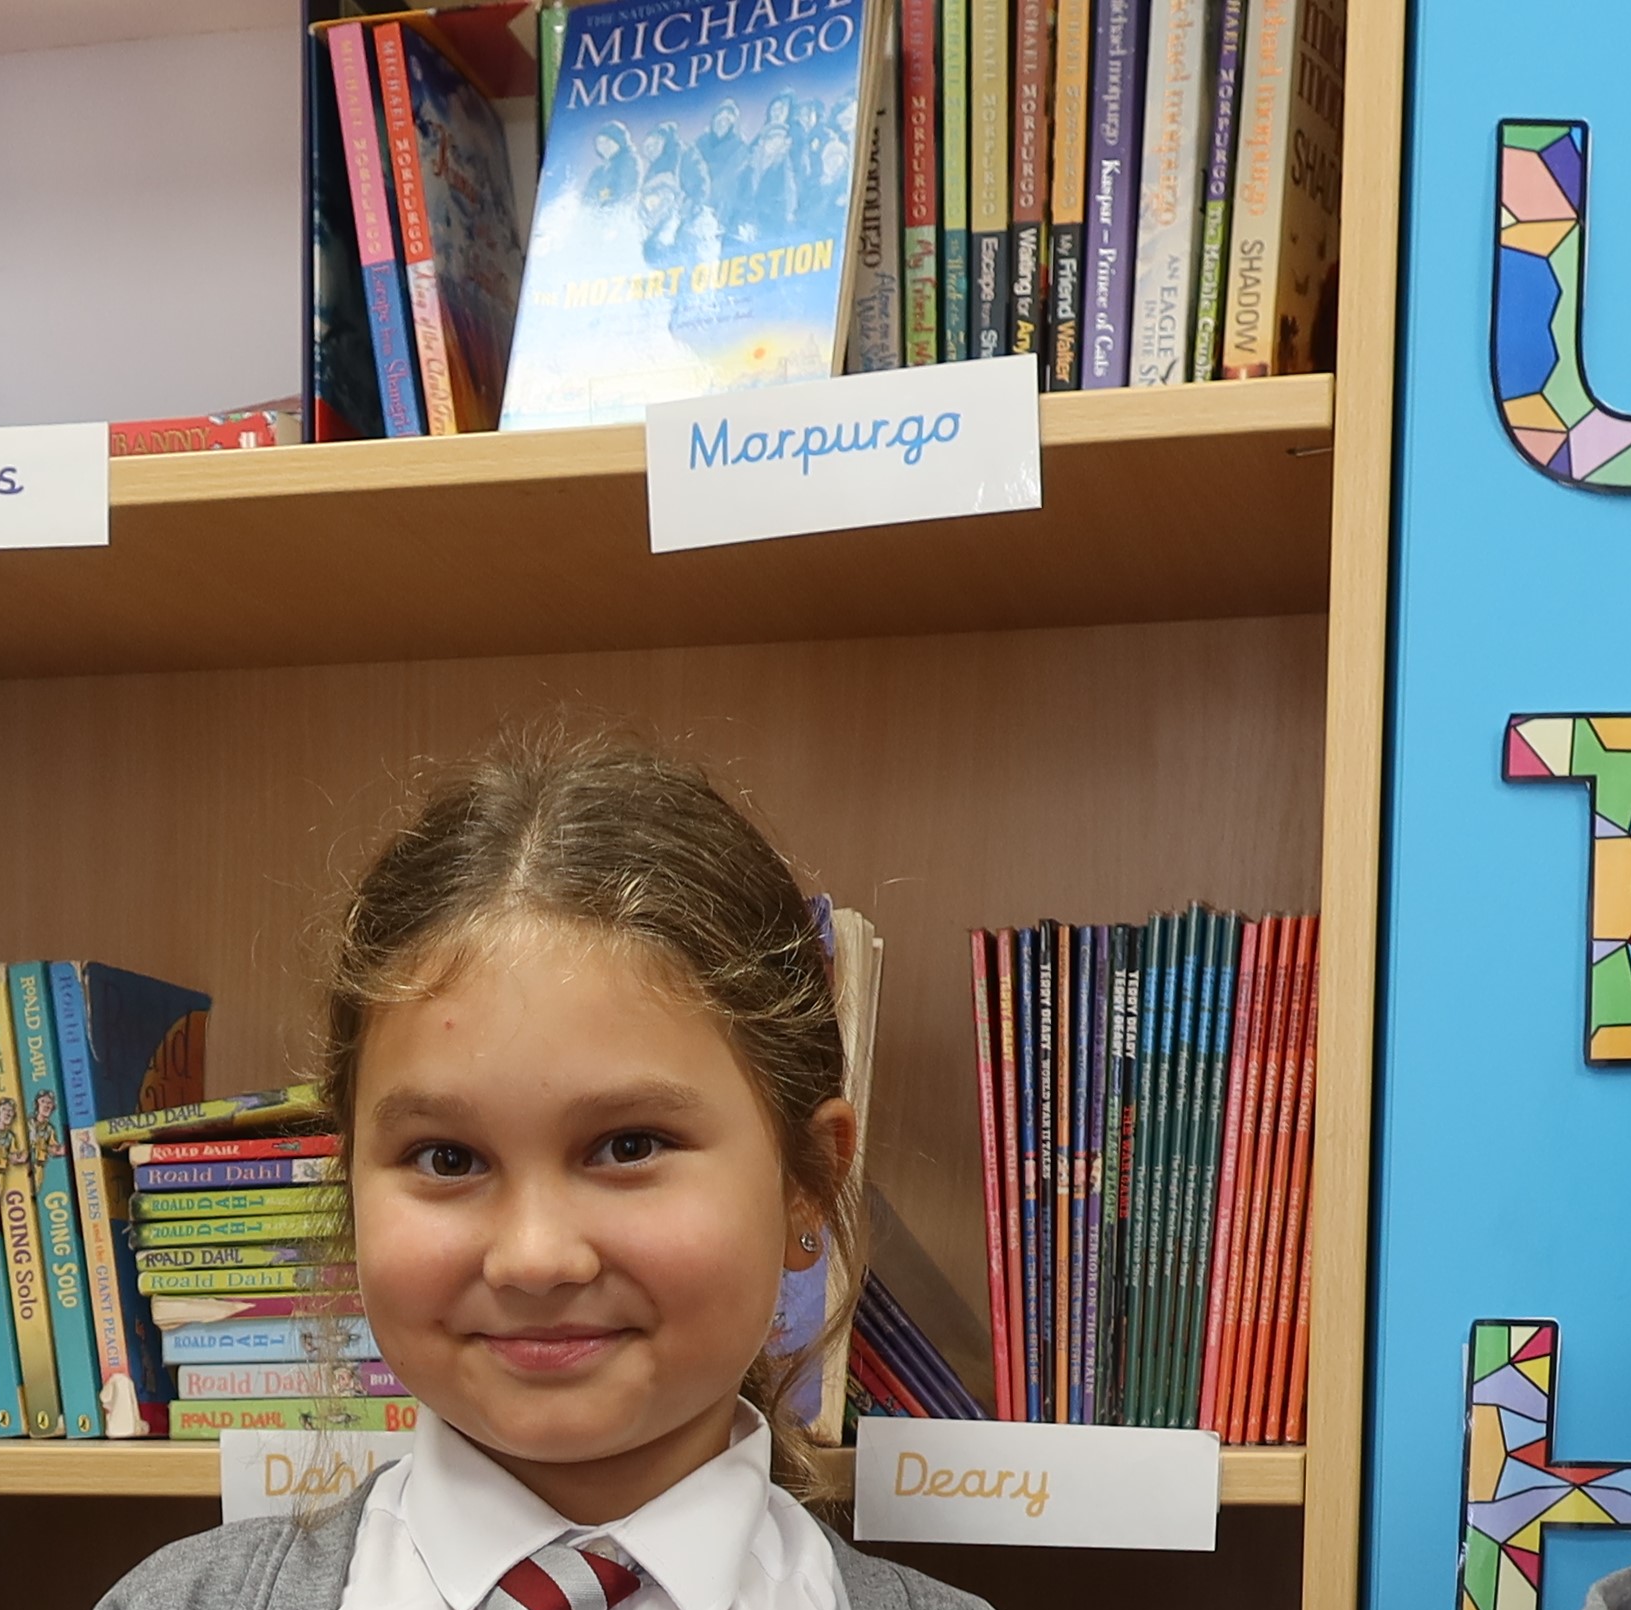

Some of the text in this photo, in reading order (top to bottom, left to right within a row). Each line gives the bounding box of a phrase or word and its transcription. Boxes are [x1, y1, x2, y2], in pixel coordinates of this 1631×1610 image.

[566, 15, 855, 110] MORPURGO
[382, 39, 424, 256] MICHAEL MORPURGO
[912, 95, 928, 220] MORPURGO
[1021, 83, 1038, 208] MORPURGO
[1210, 68, 1235, 196] MORPURGO
[353, 135, 383, 257] MORPURGO
[564, 239, 834, 311] MOZART QUESTION
[977, 236, 999, 302] Escape
[1014, 227, 1037, 297] Waiting
[1093, 159, 1121, 378] Kaspar Prince of Cats
[1017, 297, 1034, 320] for
[1054, 233, 1079, 384] My Friend Walter
[1158, 253, 1182, 358] AN EAGLE
[1234, 239, 1266, 355] SHADOW
[1141, 299, 1158, 359] IN THE
[689, 409, 963, 476] Morpurgo
[19, 974, 42, 1032] ROALD
[1040, 963, 1053, 1008] TERRY
[27, 1032, 48, 1083] DAHL
[1040, 1008, 1053, 1051] DEARY
[1112, 1009, 1126, 1058] DEARY
[1125, 1013, 1139, 1060] DEARY
[108, 1101, 207, 1136] ROALD DAHL
[147, 1162, 283, 1186] Roald Dahl
[152, 1144, 242, 1160] ROALD DAHL
[5, 1188, 33, 1266] GOING
[43, 1189, 71, 1260] GOING
[151, 1195, 266, 1214] ROALD DAHL
[196, 1221, 264, 1236] DAHL
[80, 1169, 120, 1369] JAMES and the GIANT PEACH
[145, 1247, 244, 1268] ROALD DAHL
[150, 1267, 286, 1290] Roald Dahl
[14, 1269, 35, 1321] Solo
[173, 1333, 286, 1350] ROALD DAHL
[186, 1369, 397, 1397] Roald Dahl BOY
[179, 1411, 235, 1429] ROALD
[240, 1411, 288, 1429] DAHL
[893, 1450, 1052, 1518] Deary
